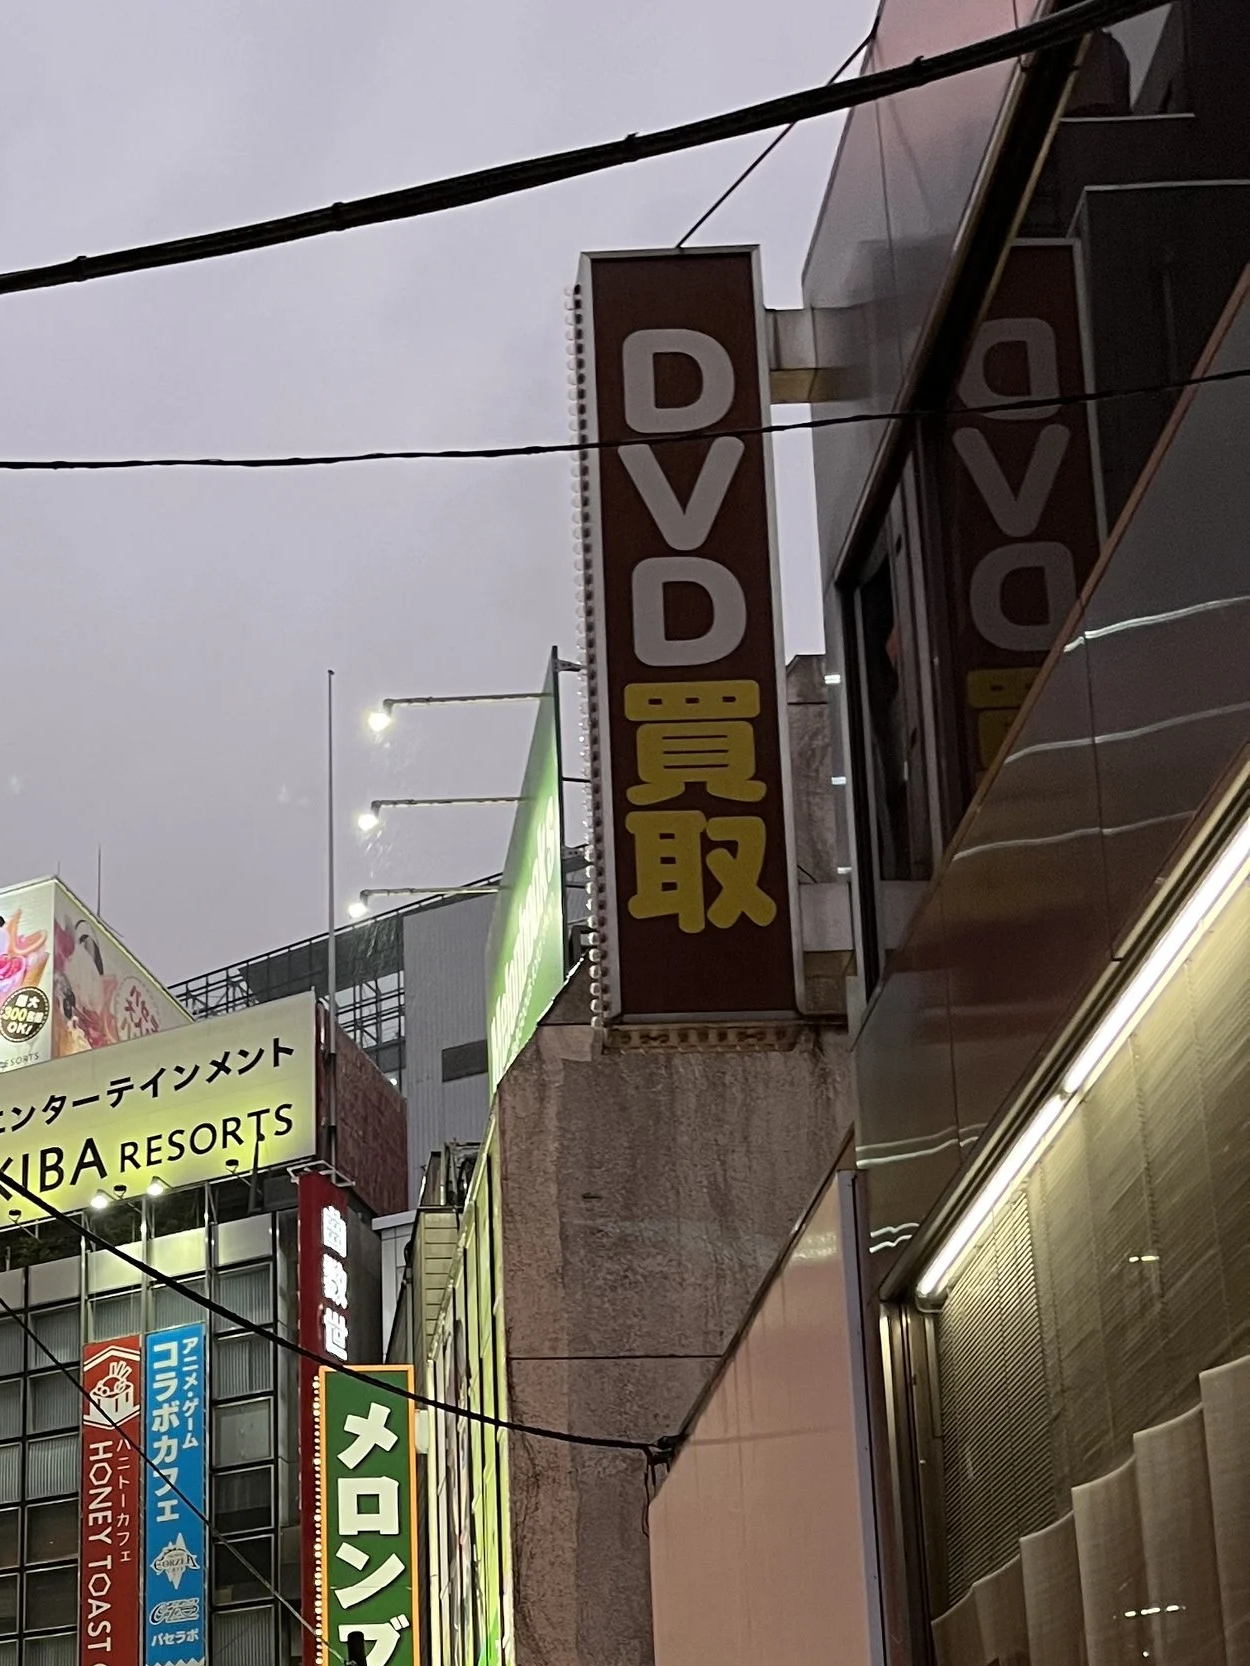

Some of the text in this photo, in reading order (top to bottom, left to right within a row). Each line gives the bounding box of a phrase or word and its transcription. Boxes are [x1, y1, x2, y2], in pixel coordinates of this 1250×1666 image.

[7, 1022, 32, 1036] OK!
[119, 1103, 294, 1173] RESORTS
[151, 1340, 180, 1523] コラボカフェ
[181, 1337, 199, 1449] アニメ・ゲーム
[88, 1440, 113, 1546] HONEY
[116, 1439, 132, 1562] ハニトーカフェ
[87, 1554, 112, 1652] TOAST
[151, 1628, 199, 1647] パセラボ
